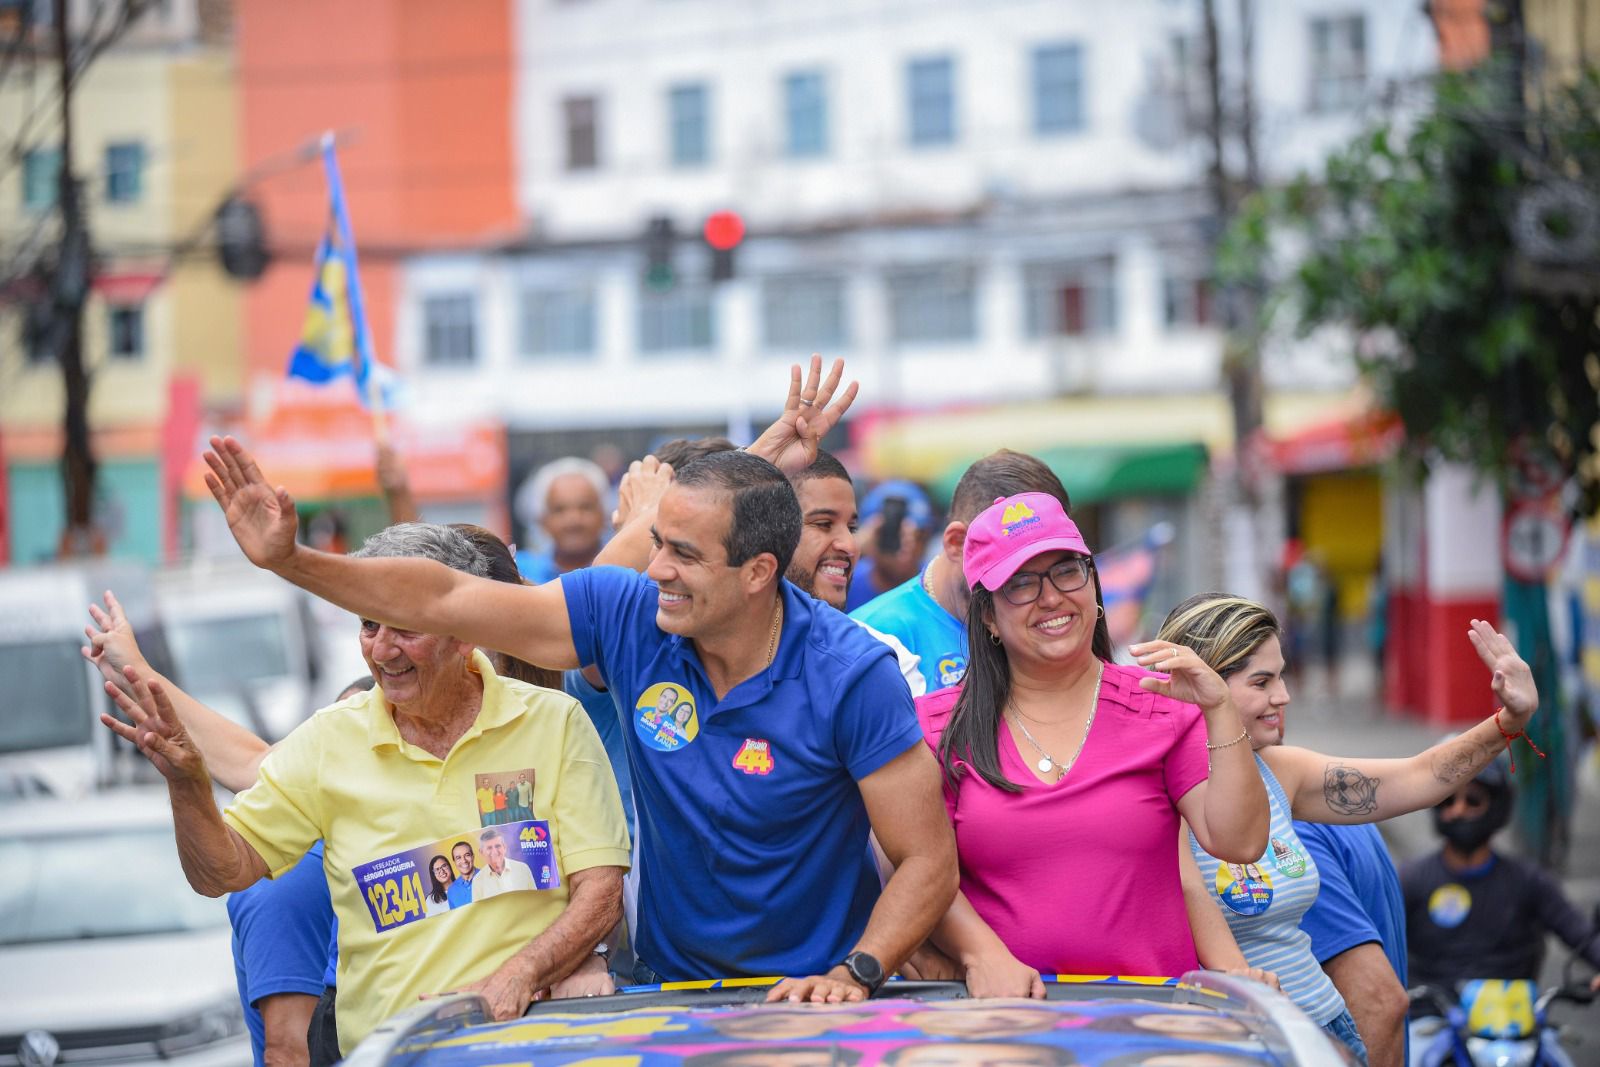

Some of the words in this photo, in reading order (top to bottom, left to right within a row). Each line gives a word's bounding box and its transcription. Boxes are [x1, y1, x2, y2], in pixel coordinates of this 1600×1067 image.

[735, 748, 771, 772] 44
[519, 827, 539, 842] 44
[521, 841, 548, 849] BRUNO
[372, 857, 401, 871] VEREADOR
[384, 860, 416, 876] NOGUEIRA
[368, 871, 428, 927] 12341
